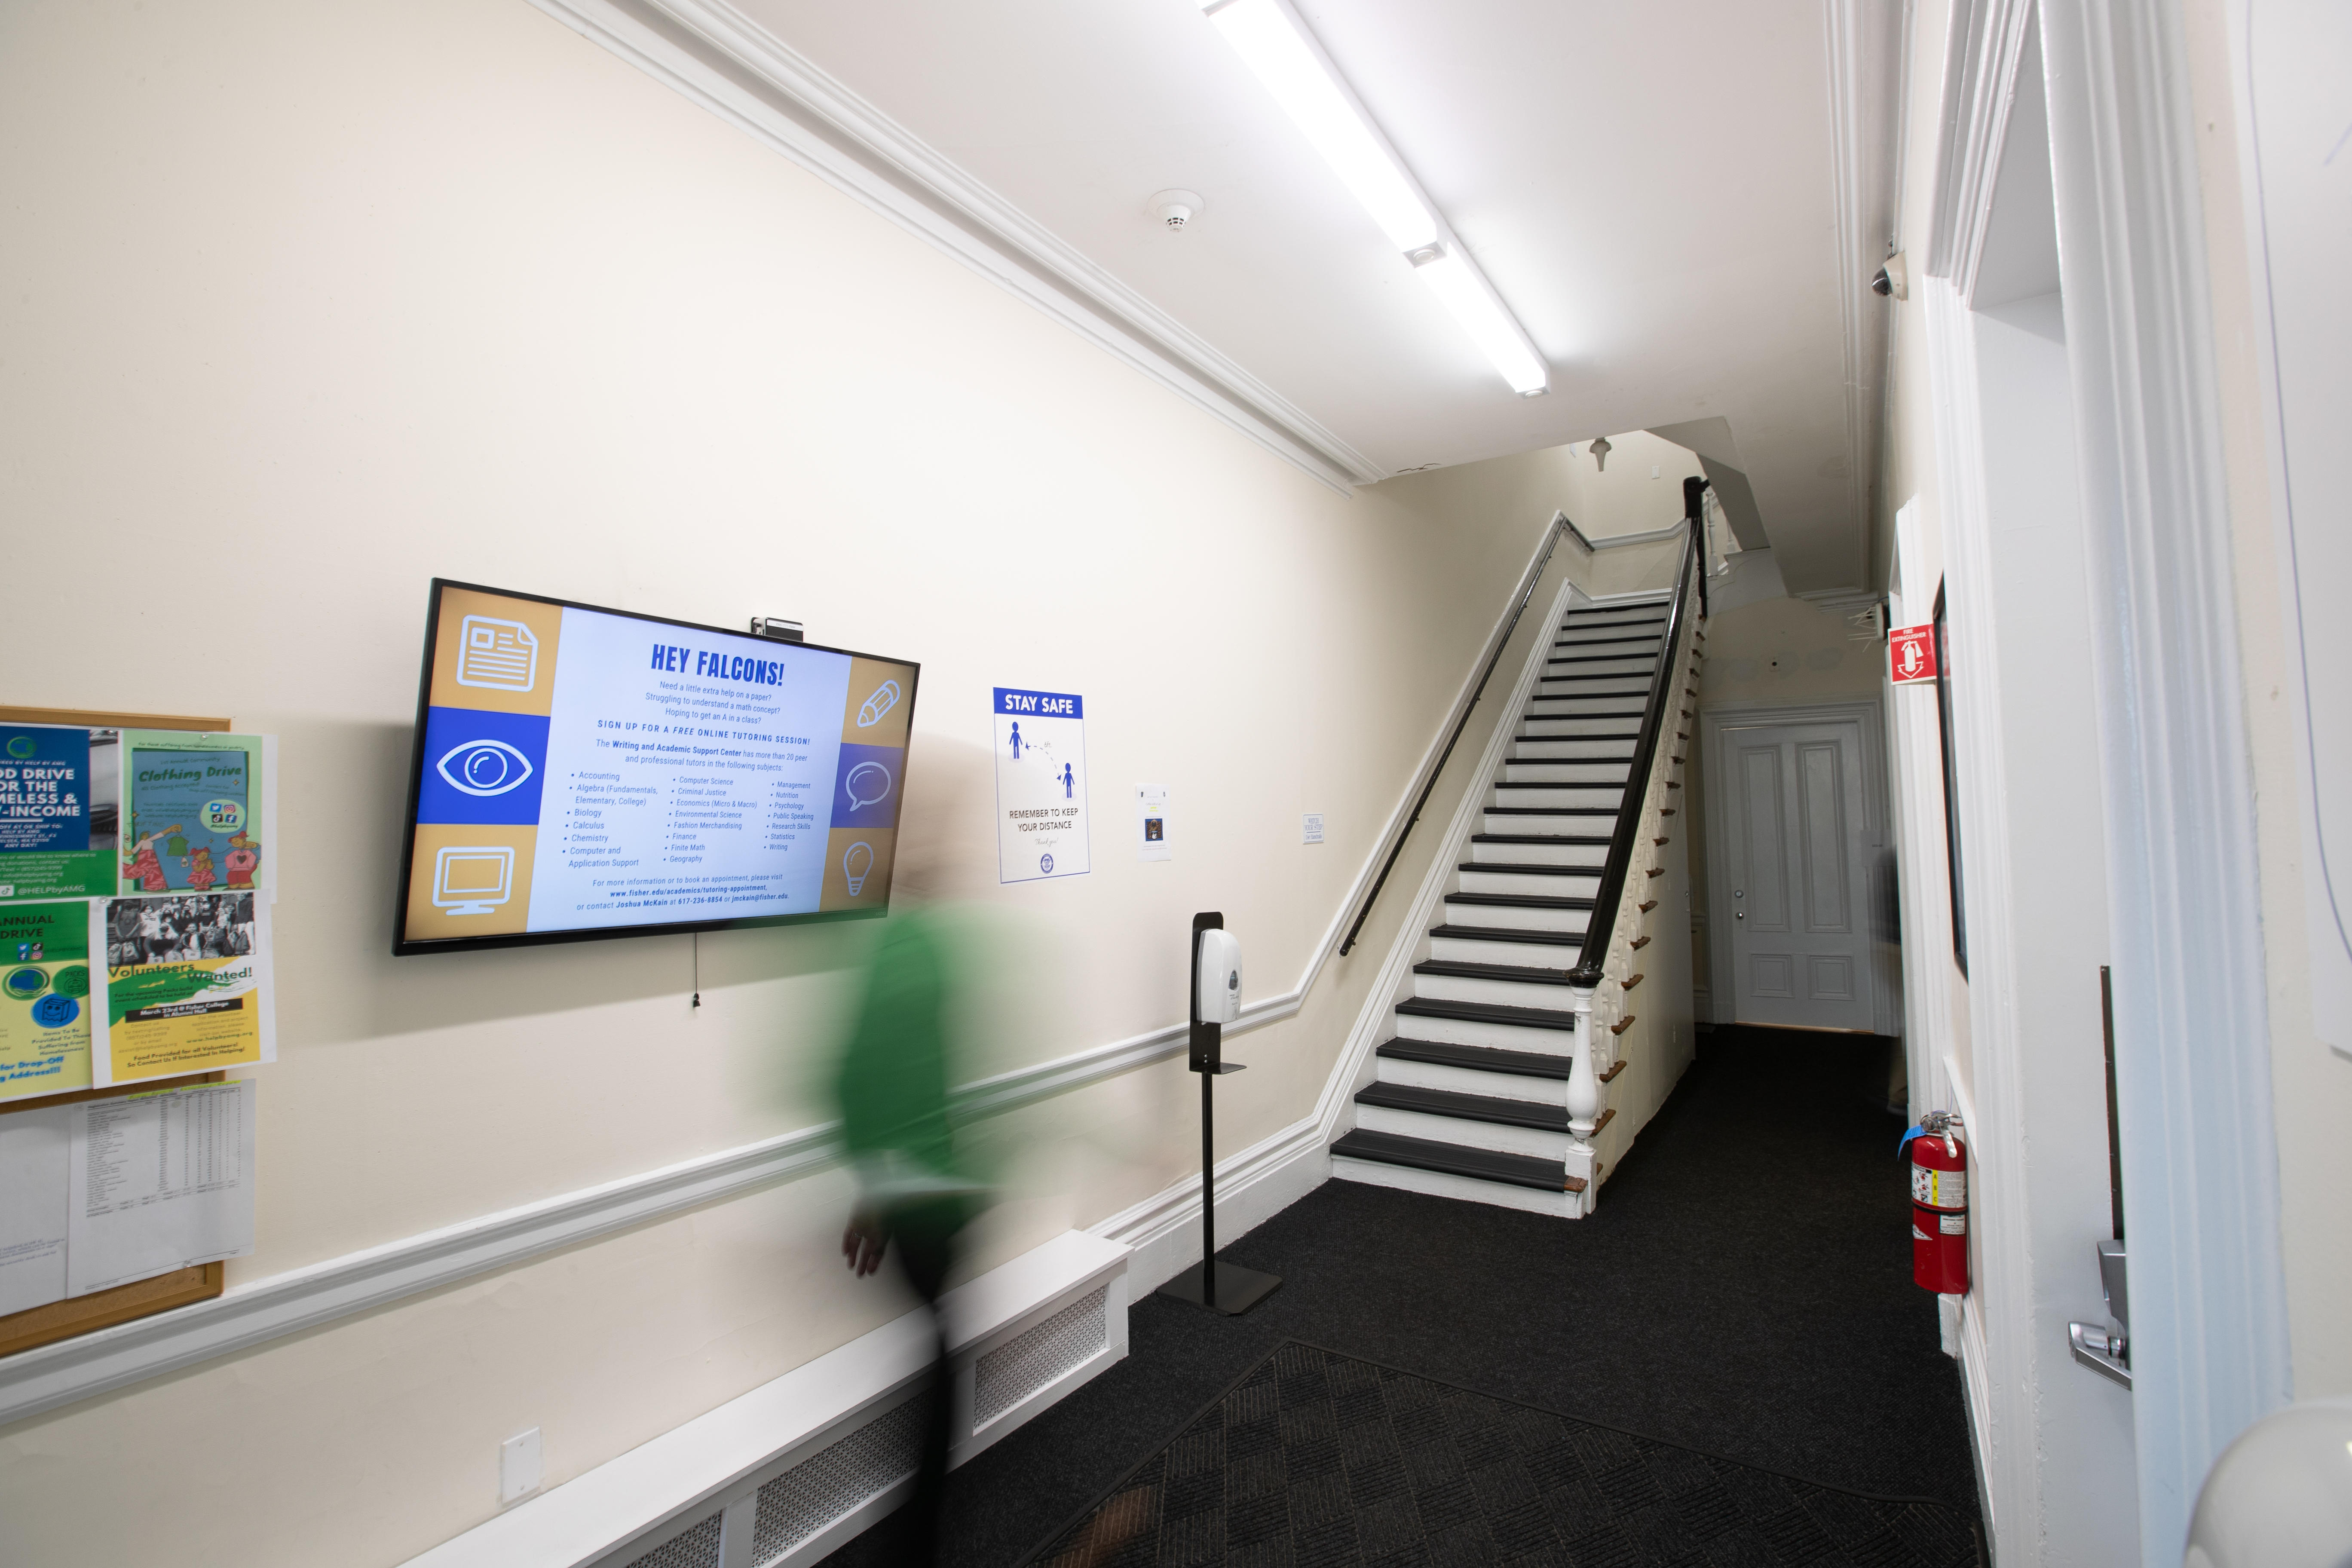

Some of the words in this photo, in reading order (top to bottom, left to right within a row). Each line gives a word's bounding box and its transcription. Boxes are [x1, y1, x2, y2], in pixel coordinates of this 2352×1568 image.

[1892, 632, 1926, 643] EXTINGUISHER
[651, 644, 690, 673] HEY
[696, 651, 784, 686] FALCONS!
[660, 681, 678, 690] Need
[686, 684, 701, 693] little
[720, 688, 735, 698] help
[750, 694, 772, 702] paper?
[645, 692, 681, 705] Struggling
[692, 698, 729, 708] understand
[753, 706, 780, 715] concept?
[1005, 694, 1037, 712] STAY
[1042, 697, 1073, 714] SAFE
[665, 707, 690, 719] Hoping
[700, 712, 711, 720] get
[741, 716, 761, 724] class?
[597, 720, 621, 729] SIGN
[625, 722, 637, 730] UP
[642, 724, 659, 732] FOR
[673, 726, 694, 735] FREE
[698, 729, 728, 738] ONLINE
[732, 732, 772, 742] TUTORING
[775, 736, 810, 745] SESSION!
[596, 739, 610, 747] The
[612, 740, 639, 751] Writing
[656, 744, 690, 753] Academic
[692, 746, 719, 756] Support
[720, 748, 741, 756] Center
[640, 756, 684, 766] professional
[727, 760, 755, 771] following
[756, 763, 783, 772] subjects:
[22, 768, 74, 780] DRIVE
[138, 769, 202, 782] Clothing
[206, 766, 242, 777] Drive
[578, 771, 620, 782] Accounting
[24, 780, 58, 792] THE
[679, 776, 709, 785] Computer
[777, 781, 811, 790] Management
[576, 784, 604, 793] Algebra
[606, 784, 658, 794] (Fundamentals,
[64, 793, 78, 804] &
[575, 796, 616, 806] Elementary,
[619, 797, 646, 807] College)
[711, 799, 730, 808] (Micro
[737, 801, 757, 809] Macro)
[774, 802, 804, 811] Psychology
[574, 808, 602, 818] Biology
[790, 812, 814, 821] Speaking
[1009, 809, 1048, 819] REMEMBER
[1062, 808, 1078, 816] KEEP
[699, 822, 742, 830] Merchandising
[1018, 823, 1037, 832] YOUR
[1039, 821, 1072, 830] DISTANCE
[571, 834, 608, 843] Chemistry
[1049, 837, 1058, 848] you!
[570, 847, 606, 856] Computer
[769, 843, 787, 851] Writing
[568, 859, 609, 869] Application
[612, 859, 639, 868] Support
[669, 855, 702, 864] Geography
[711, 875, 749, 883] appointment,
[18, 885, 86, 895] @HELPbyAMG
[610, 885, 767, 897] www.fisher.edu/academics/tutoring-appointment,
[678, 896, 722, 904] 617-236-8854
[731, 893, 789, 903] jmckain@fisher.edu.
[0, 915, 55, 926] NNUAL
[1, 928, 43, 939] DRIVE
[109, 964, 195, 978] Volunteers
[187, 967, 252, 983] Wanted!
[18, 1056, 64, 1068] Drop-Off
